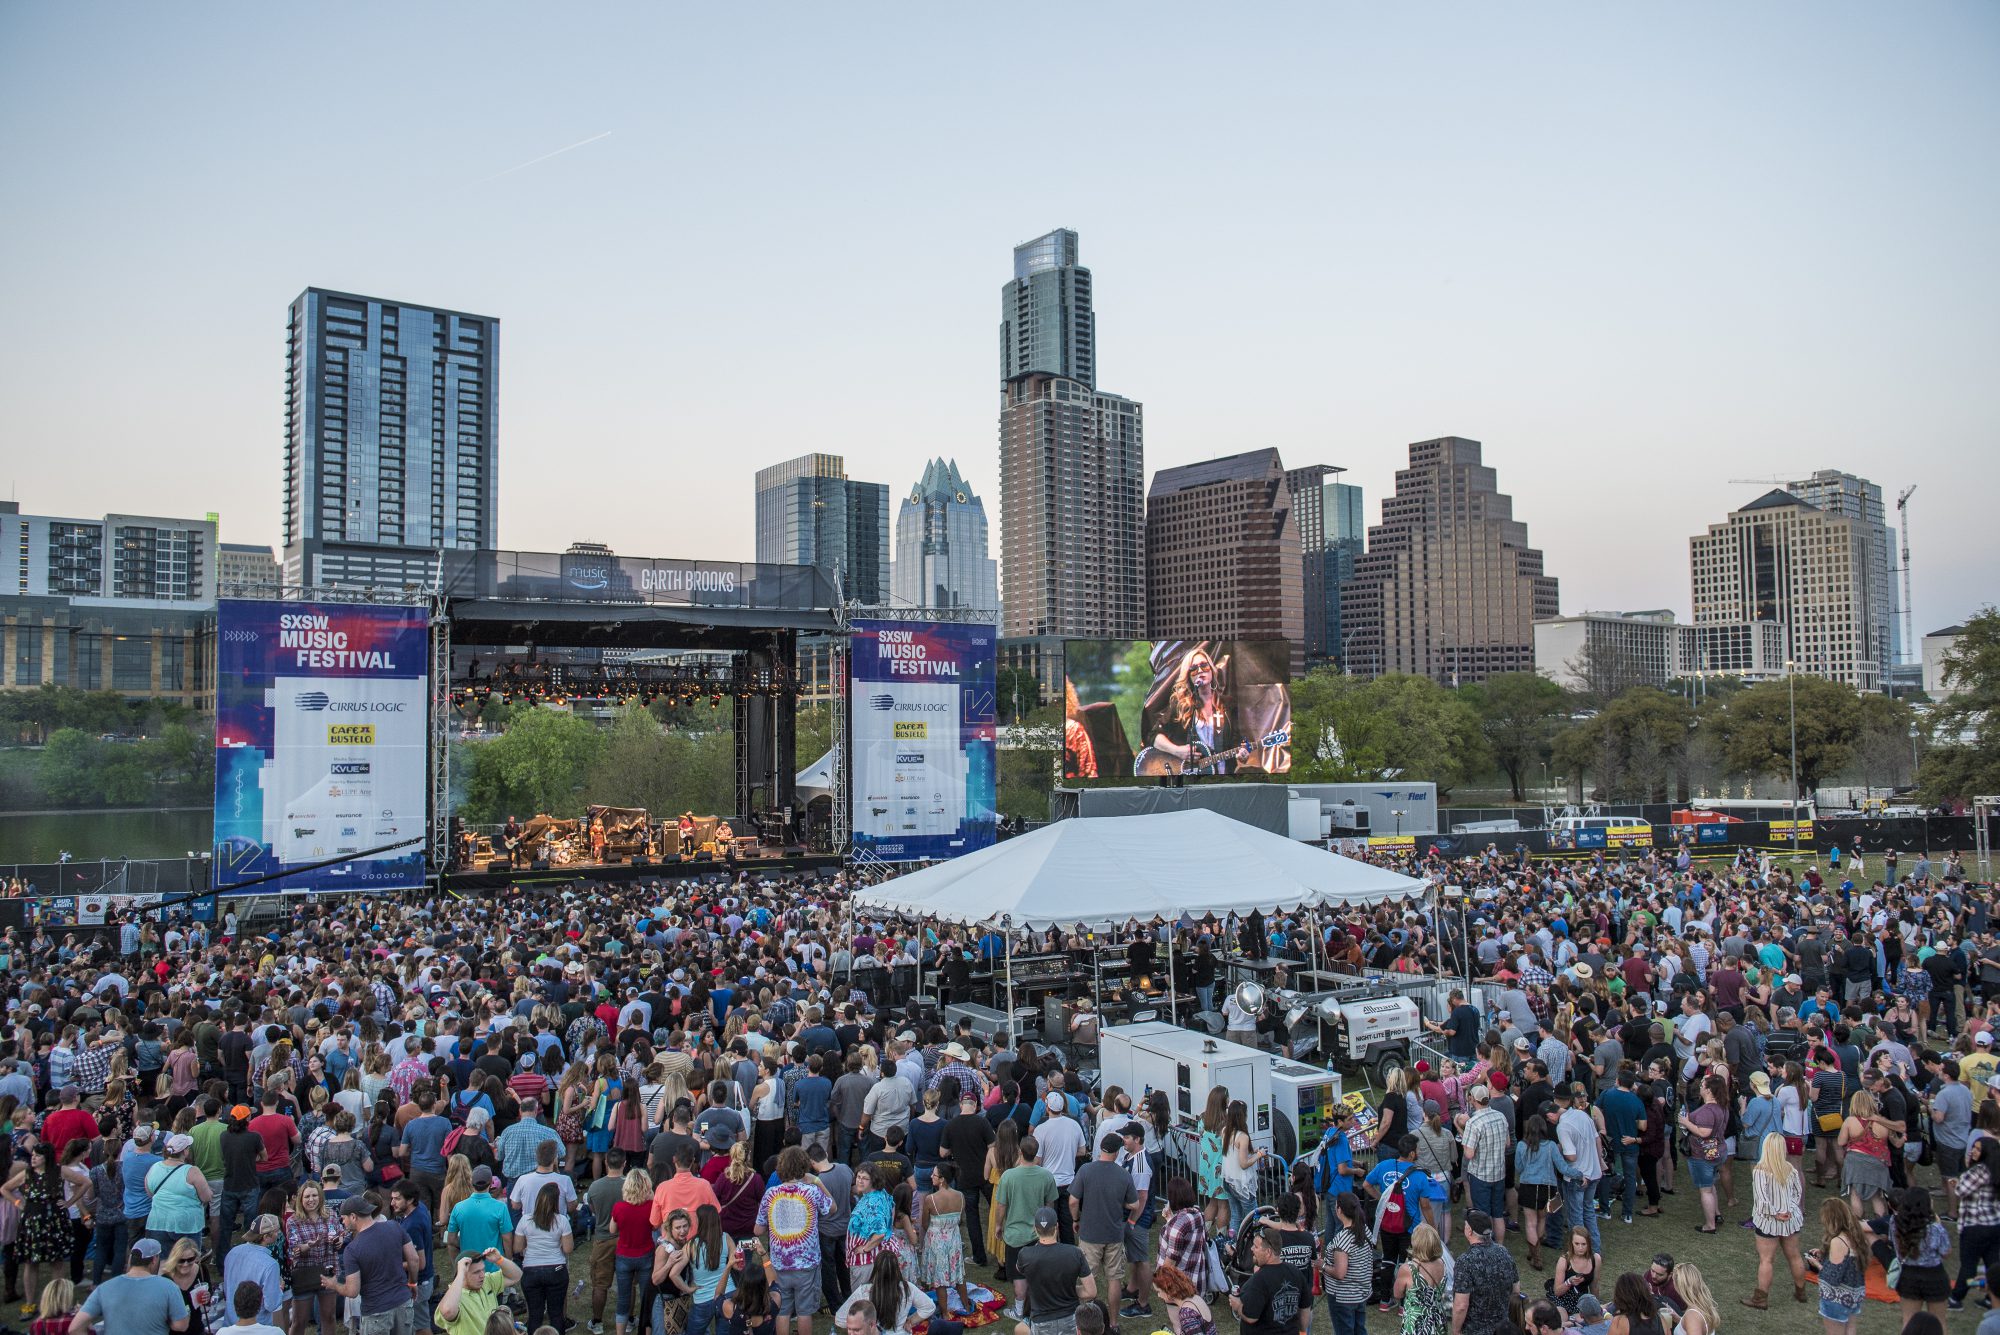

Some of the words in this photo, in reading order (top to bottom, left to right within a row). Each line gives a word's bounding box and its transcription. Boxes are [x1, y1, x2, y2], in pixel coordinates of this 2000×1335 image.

[569, 565, 607, 579] music
[641, 569, 681, 591] GARTH
[685, 570, 734, 592] BROOKS
[280, 614, 328, 630] SXSW
[280, 631, 348, 649] MUSIC
[878, 630, 913, 643] SXSW
[878, 643, 926, 659] MUSIC
[296, 650, 396, 669] FESTIVAL
[890, 660, 960, 676] FESTIVAL
[329, 702, 368, 712] CIRRUS
[370, 702, 404, 712] LOGIC
[894, 703, 922, 711] CIRRUS
[923, 703, 948, 712] LOGIC
[330, 735, 372, 744] BUSTELO
[897, 755, 917, 763] KVUE
[331, 764, 360, 773] KVUE
[1363, 1002, 1401, 1014] Allmand
[1390, 1029, 1402, 1037] PRO
[1282, 1247, 1310, 1255] TWISTED
